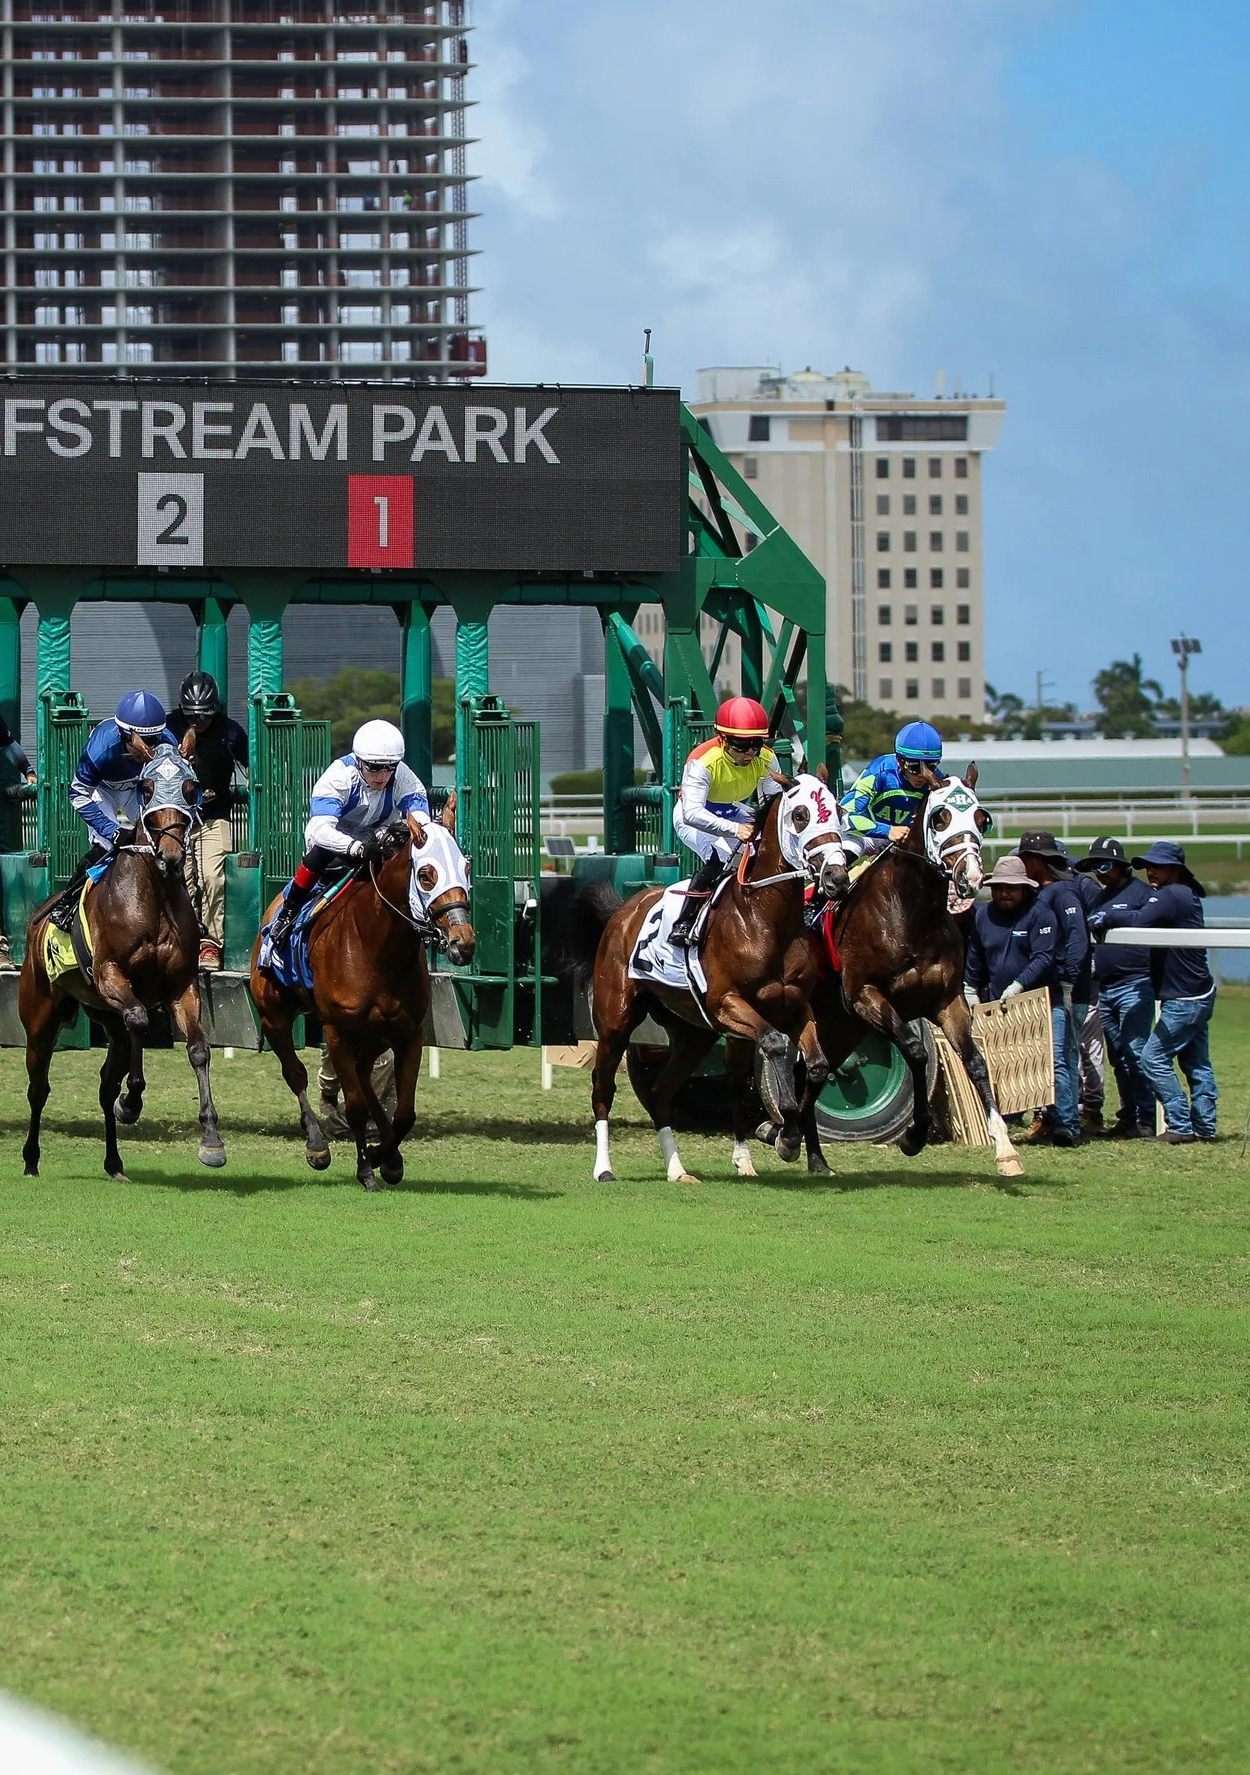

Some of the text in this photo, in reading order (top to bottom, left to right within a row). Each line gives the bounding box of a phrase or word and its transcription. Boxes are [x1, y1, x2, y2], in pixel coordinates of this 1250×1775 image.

[371, 403, 562, 465] PARK
[155, 493, 189, 545] 2
[373, 496, 389, 548] 1
[632, 907, 664, 973] 2
